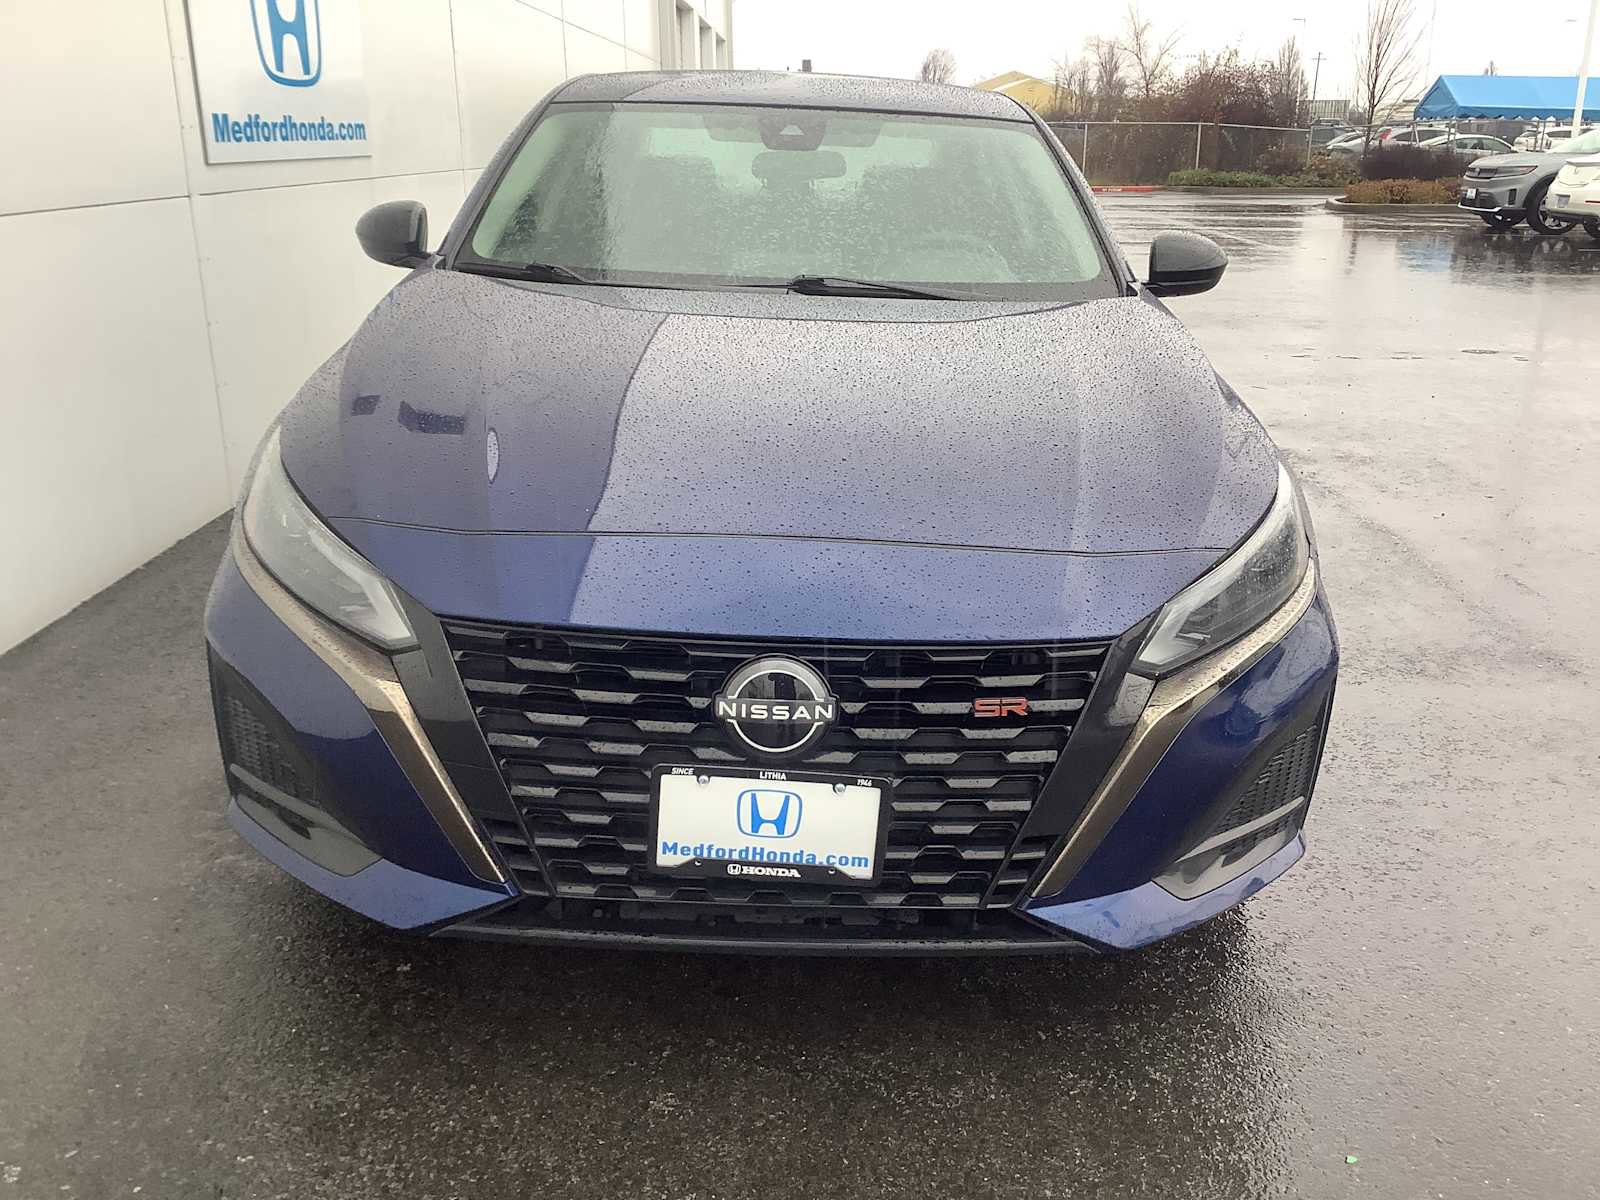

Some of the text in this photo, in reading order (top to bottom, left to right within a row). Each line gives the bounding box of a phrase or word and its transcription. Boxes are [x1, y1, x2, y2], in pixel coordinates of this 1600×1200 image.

[211, 113, 367, 143] Medfordhonda.com
[718, 701, 833, 720] NISSAN
[974, 697, 1028, 717] SR
[671, 767, 873, 787] SINCE LITHIA 1946
[661, 841, 869, 868] MedfordHonda.com
[741, 864, 801, 877] HONDA
